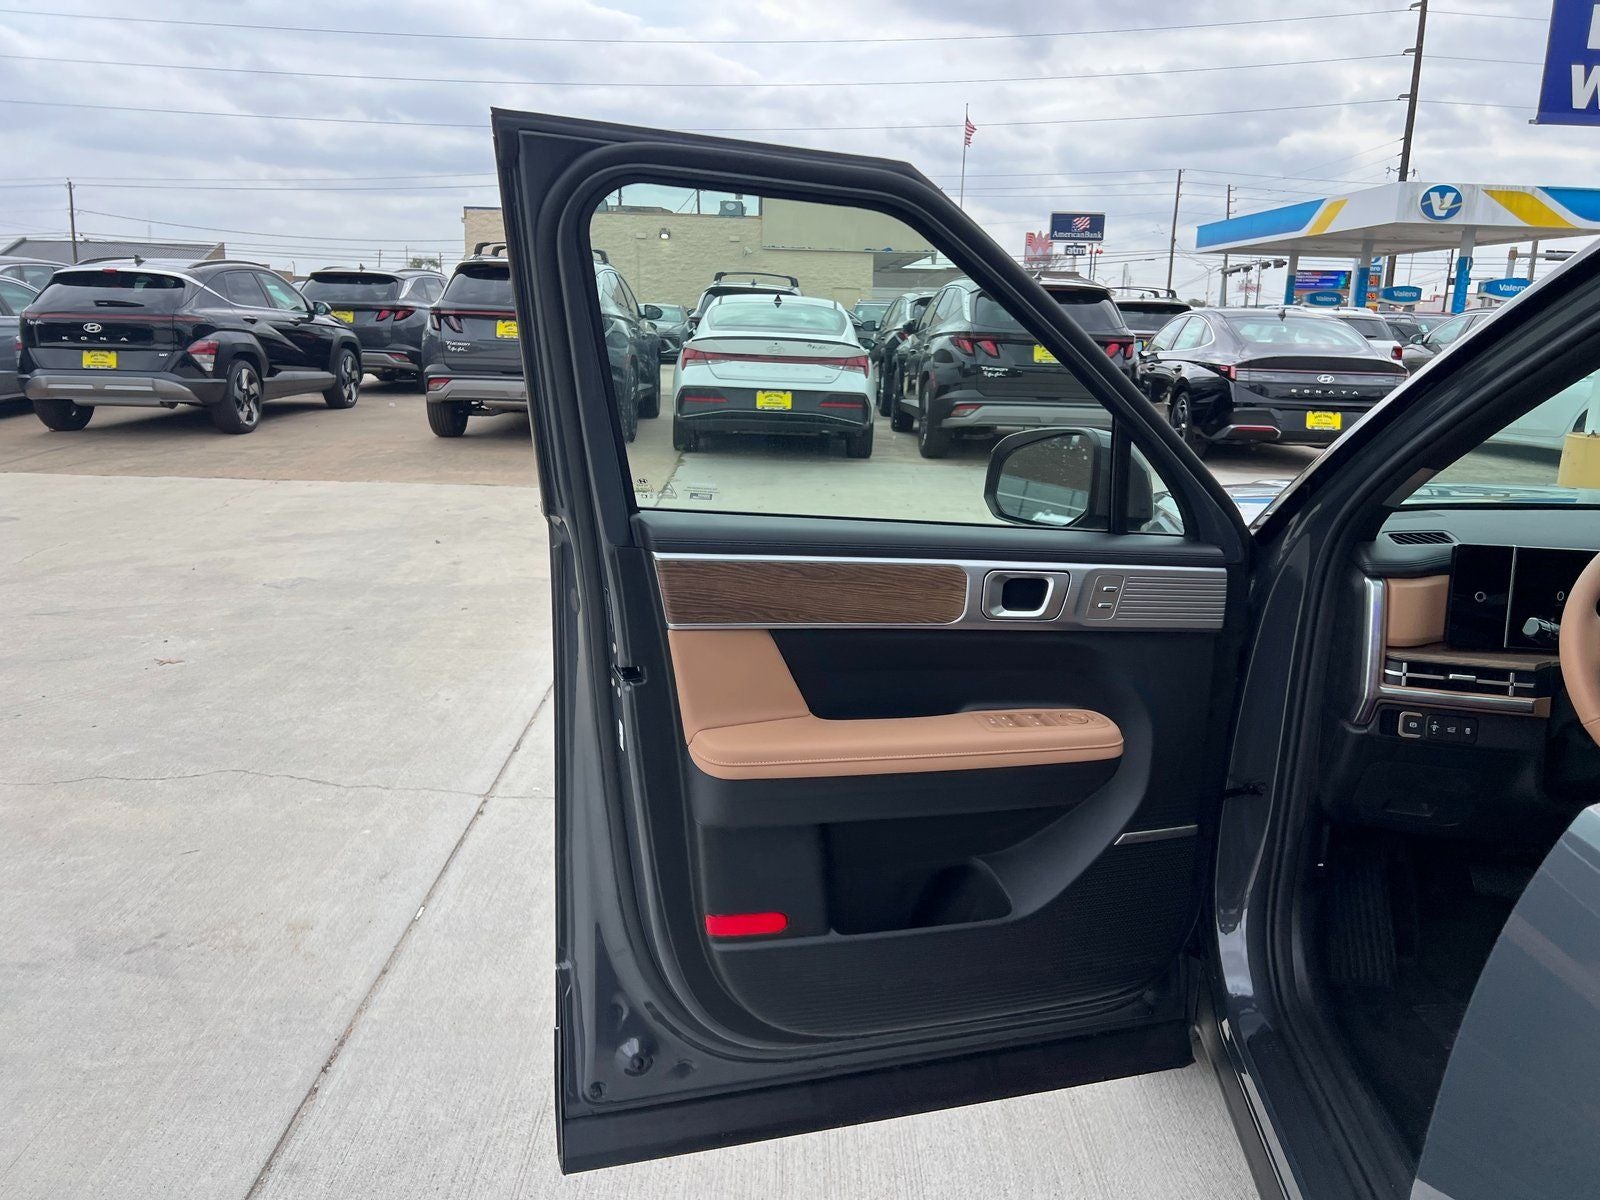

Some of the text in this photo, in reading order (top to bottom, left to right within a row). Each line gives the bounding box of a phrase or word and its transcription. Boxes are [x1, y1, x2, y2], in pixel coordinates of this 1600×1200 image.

[1052, 230, 1102, 239] AmericanBank
[1066, 246, 1086, 255] atm
[1393, 290, 1417, 298] Valero
